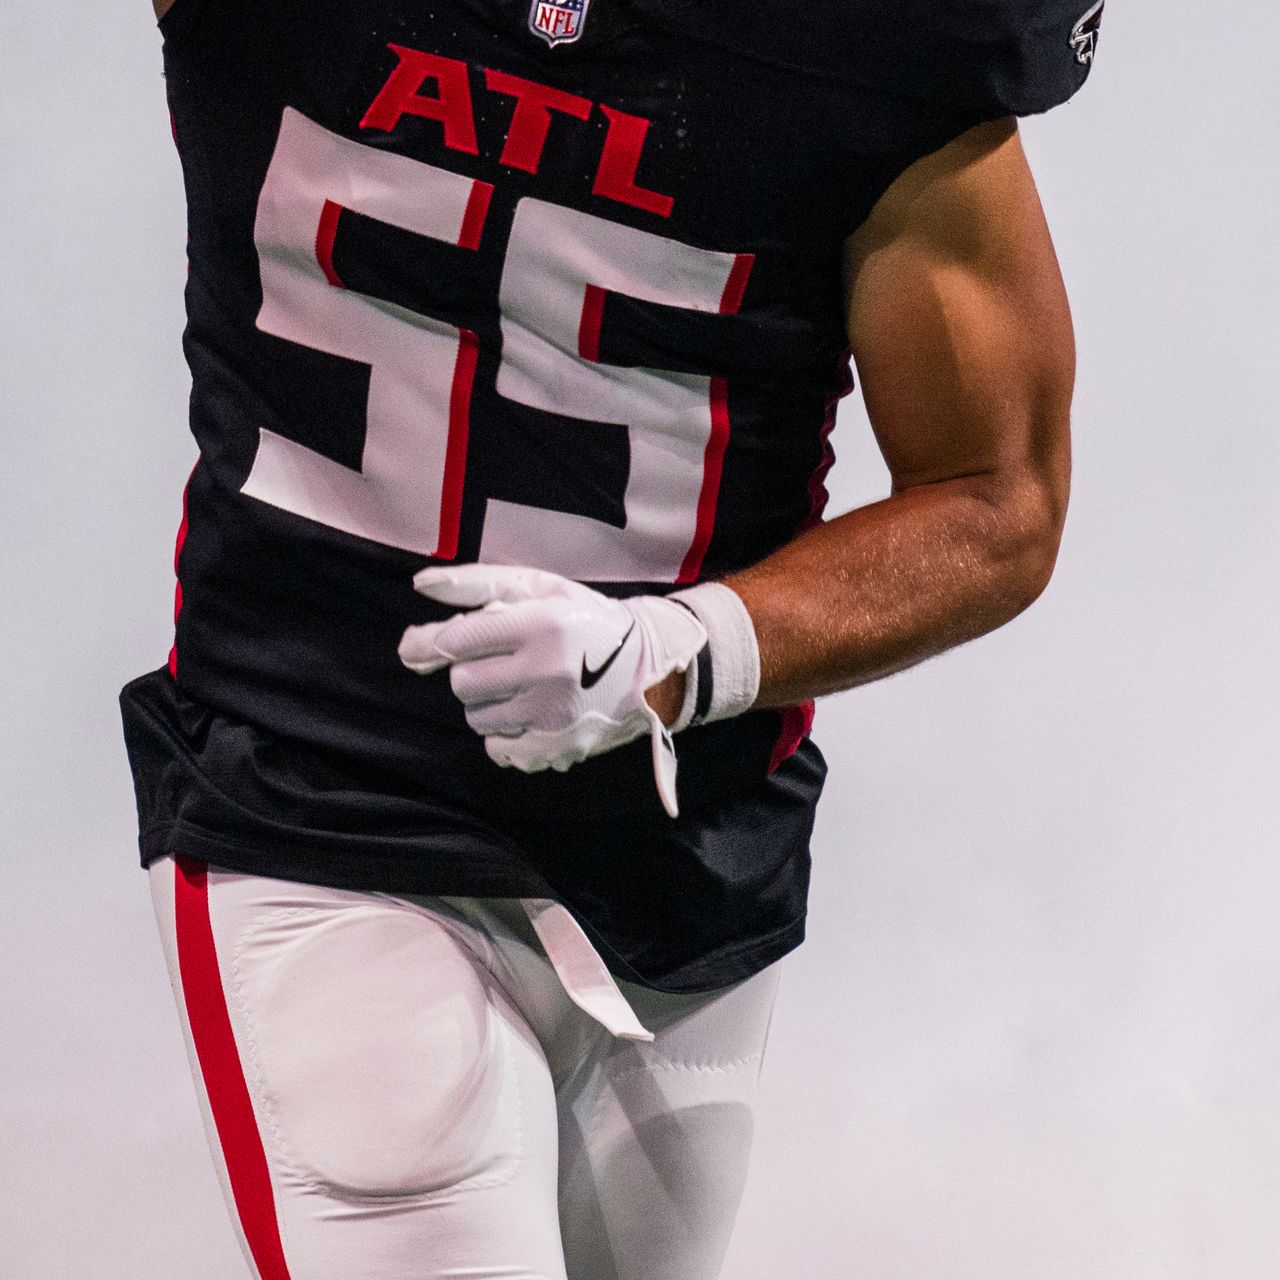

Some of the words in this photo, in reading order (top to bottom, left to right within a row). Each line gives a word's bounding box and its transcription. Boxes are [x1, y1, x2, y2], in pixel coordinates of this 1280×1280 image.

[537, 6, 575, 36] NFL
[359, 41, 676, 218] ATL
[239, 105, 756, 583] 55
